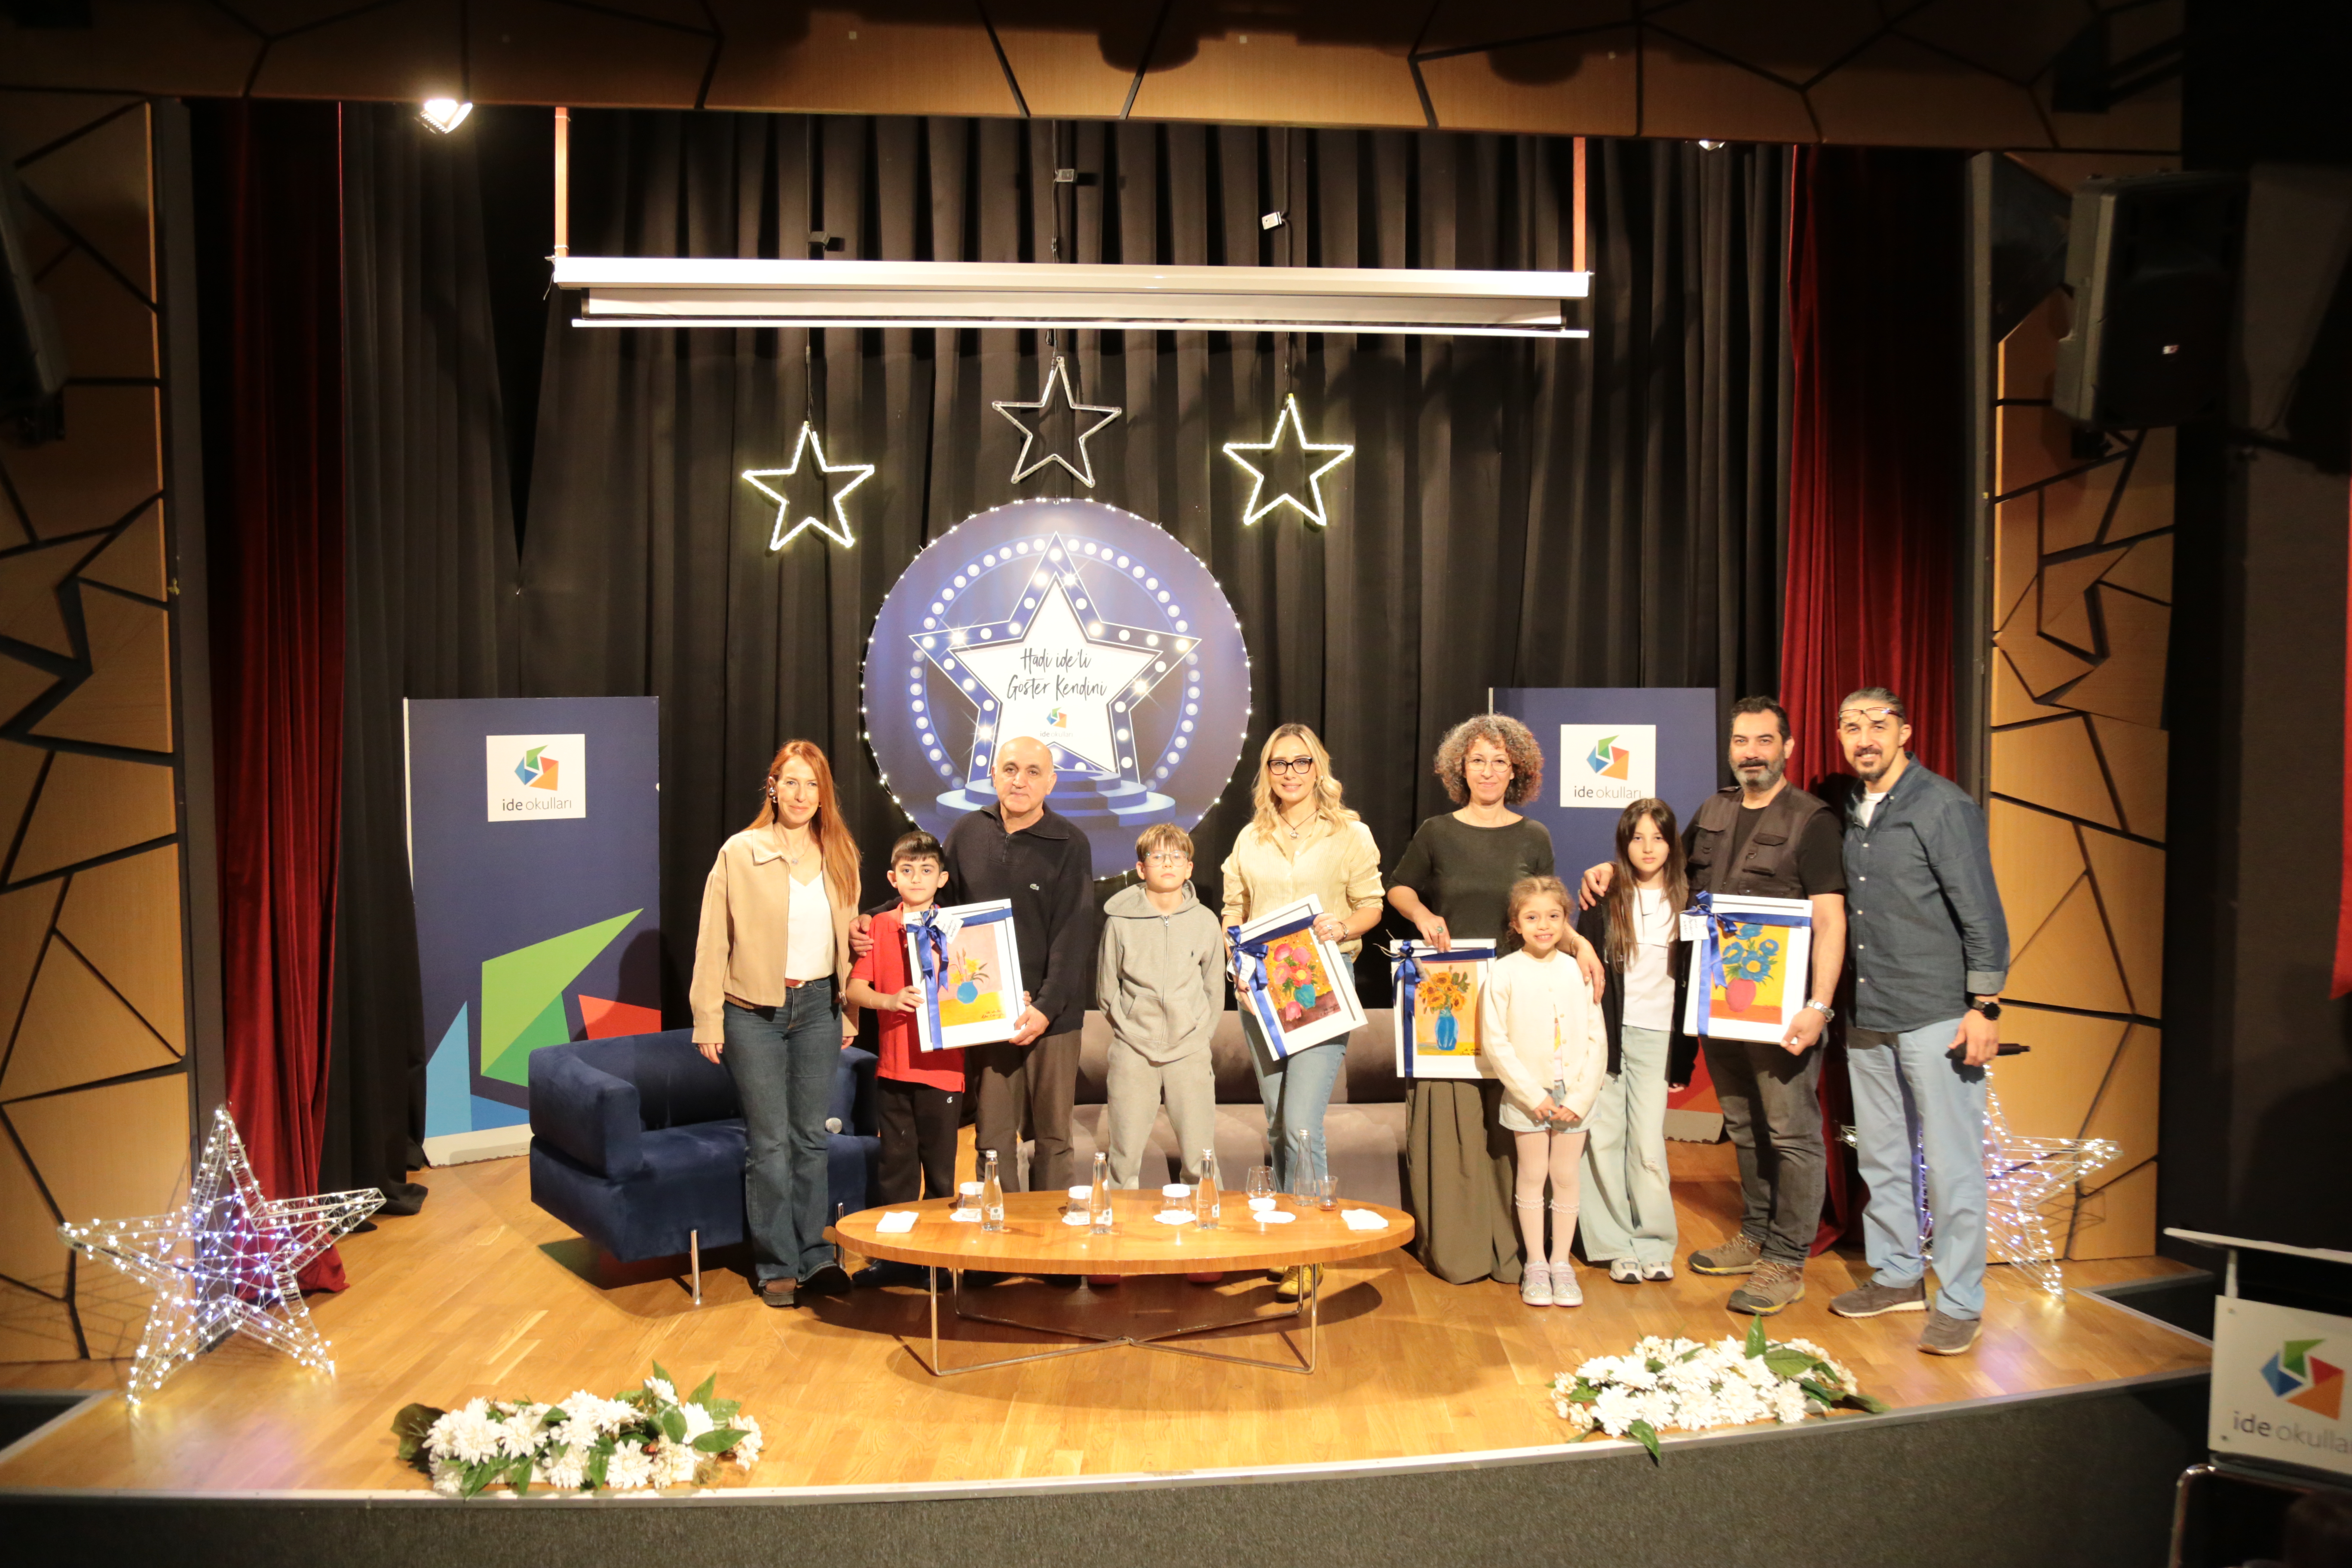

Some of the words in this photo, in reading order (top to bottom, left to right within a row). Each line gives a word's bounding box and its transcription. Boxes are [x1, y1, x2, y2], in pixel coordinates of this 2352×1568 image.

[1020, 648, 1053, 674] Hadi
[1056, 649, 1091, 673] ide'li
[1007, 674, 1050, 701] Göster
[1056, 674, 1107, 701] Kendini
[502, 798, 523, 811] ide
[526, 797, 572, 810] okulları
[1574, 786, 1593, 798] ide
[1596, 786, 1641, 798] okulları
[2233, 1410, 2272, 1437] ide
